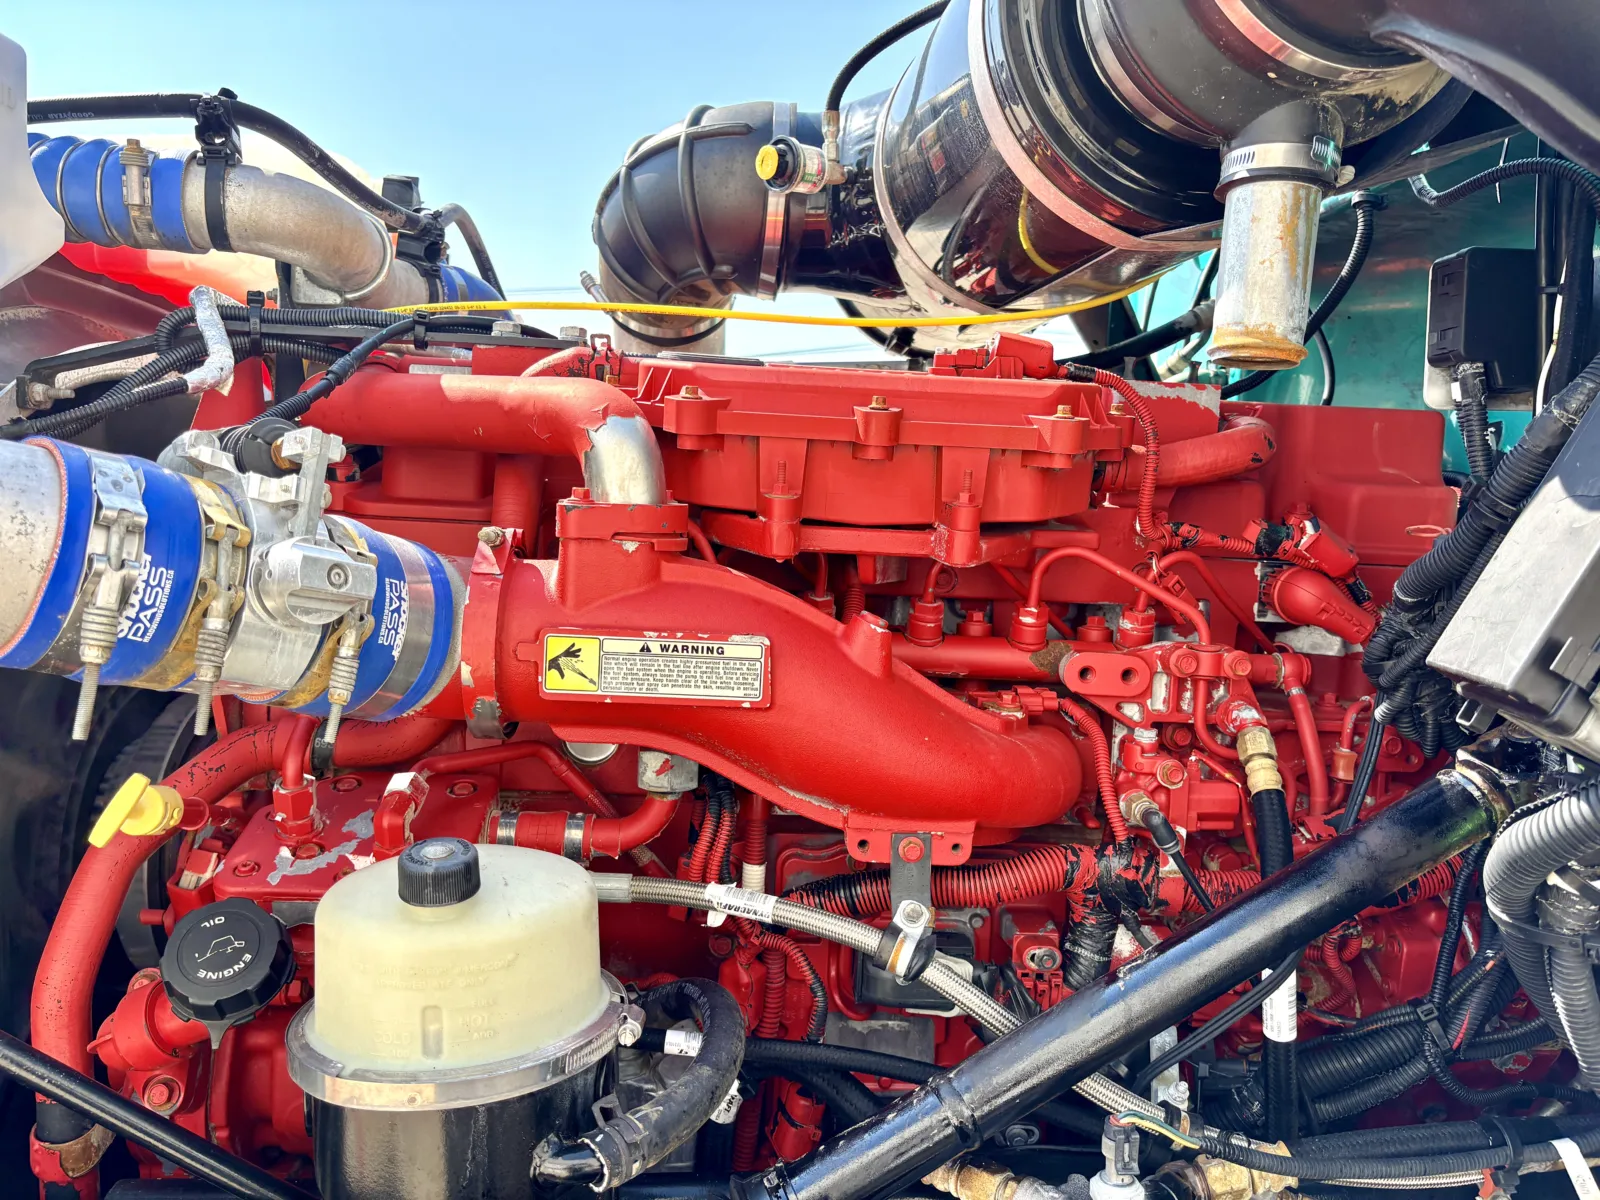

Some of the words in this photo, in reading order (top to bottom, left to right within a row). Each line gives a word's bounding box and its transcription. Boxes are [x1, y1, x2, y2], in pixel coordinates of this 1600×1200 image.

[127, 566, 167, 642] PASS
[143, 570, 175, 643] HEADWINDSOLUTIONS.CA
[378, 578, 390, 644] HEADWINDSOLUTIONS.CA
[384, 578, 400, 645] PASS
[660, 644, 724, 655] WARNING
[201, 916, 225, 928] OIL
[197, 953, 252, 979] ENGINE
[459, 1015, 490, 1027] HOT
